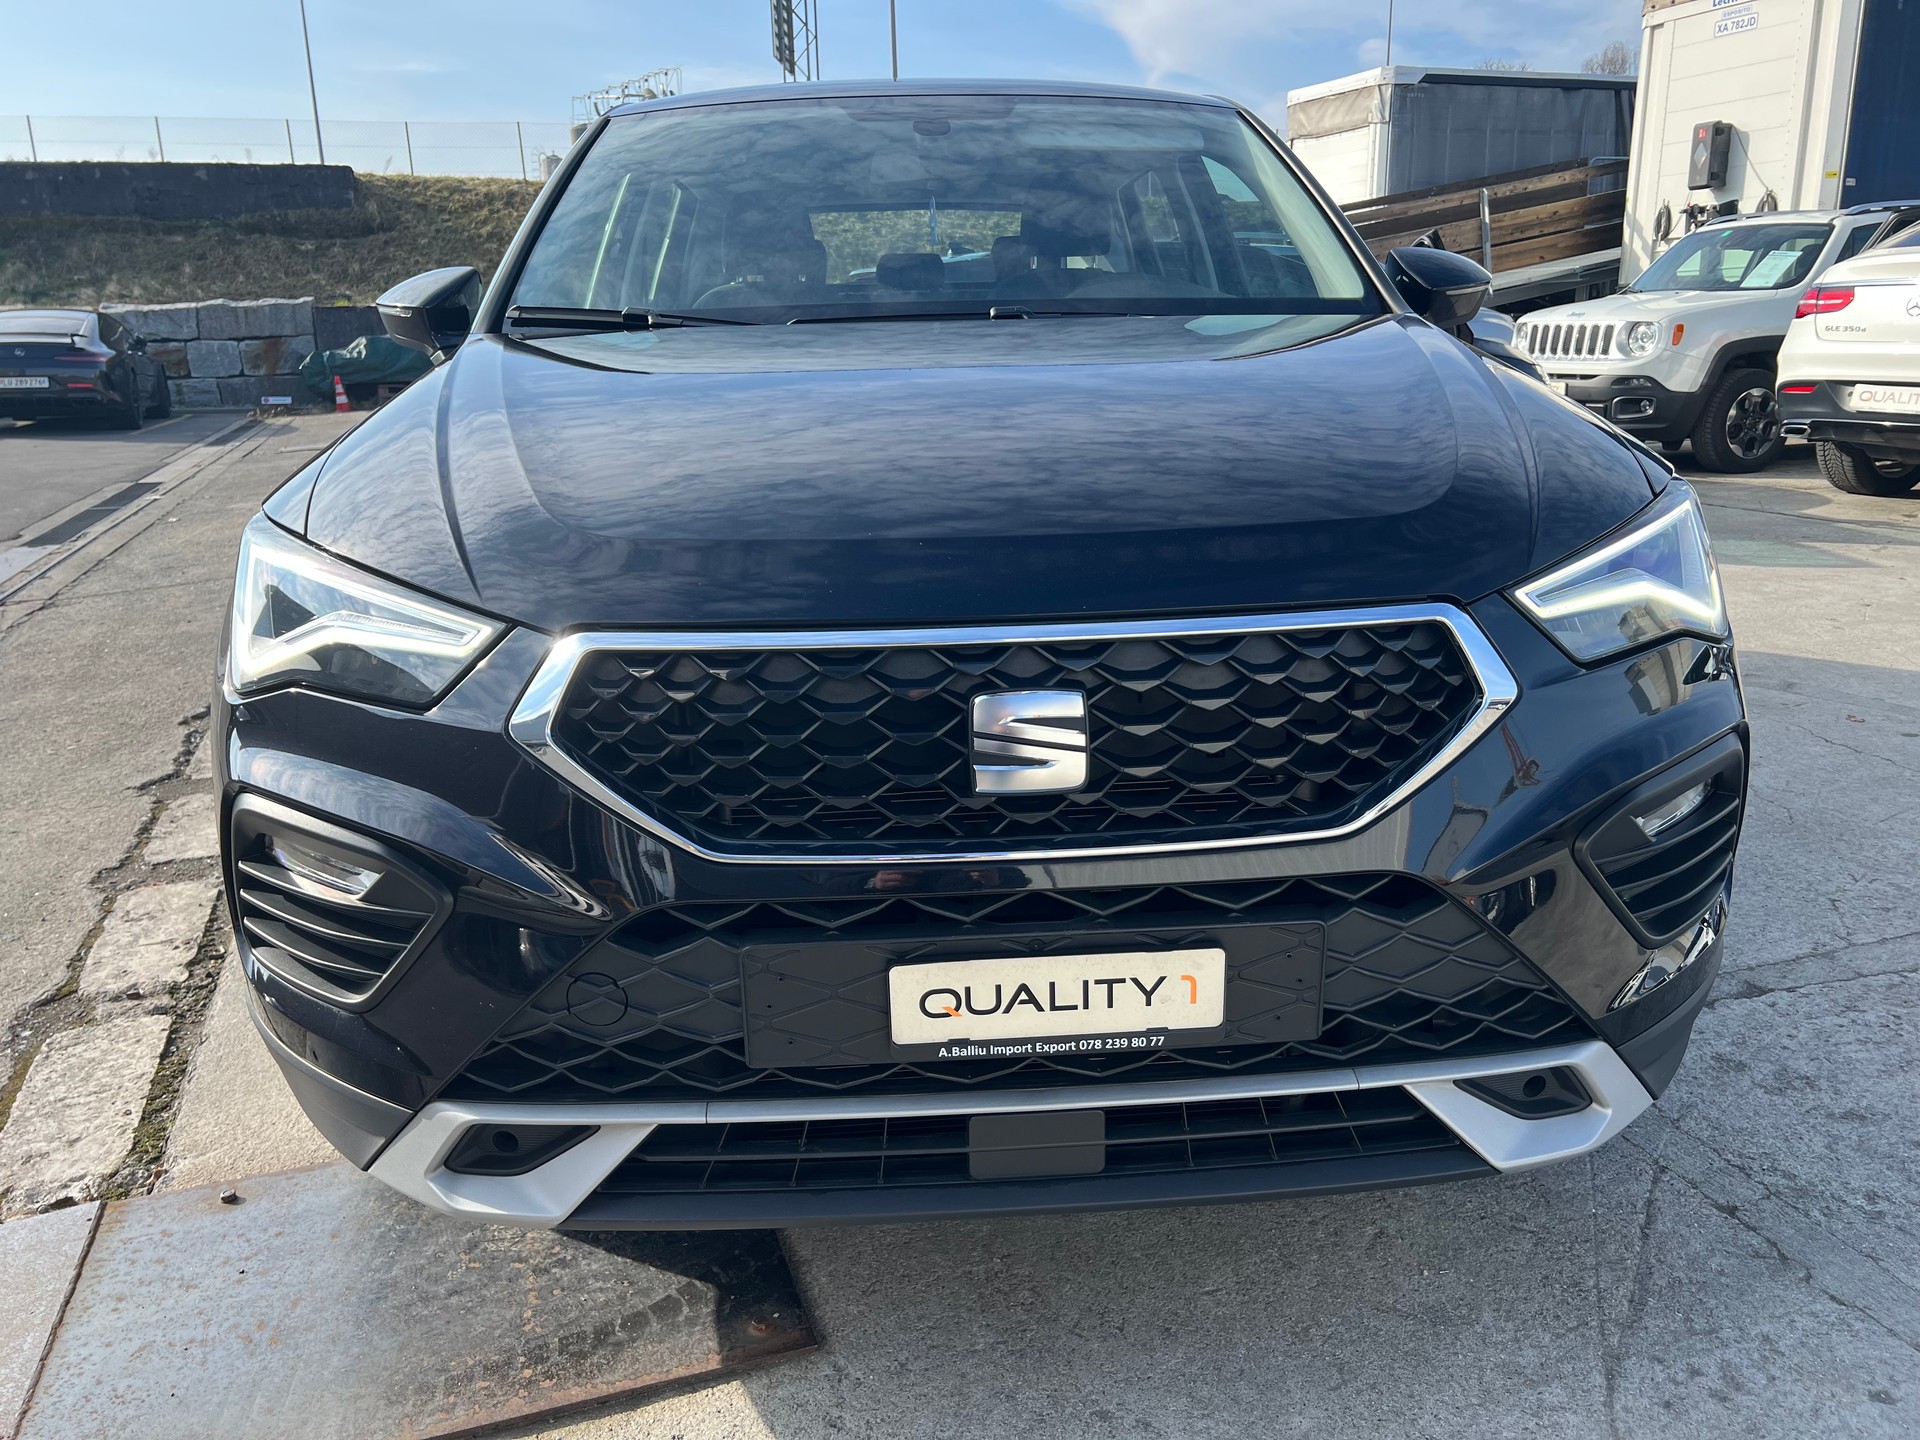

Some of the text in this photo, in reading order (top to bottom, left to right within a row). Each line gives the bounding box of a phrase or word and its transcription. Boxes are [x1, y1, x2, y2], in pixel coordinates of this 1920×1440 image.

[1716, 16, 1756, 34] XA 782JD
[1842, 325, 1867, 333] 350d
[919, 974, 1197, 1019] QUALITY 1
[938, 1036, 1165, 1058] A.Balliu Import Export 078 239 80 77
